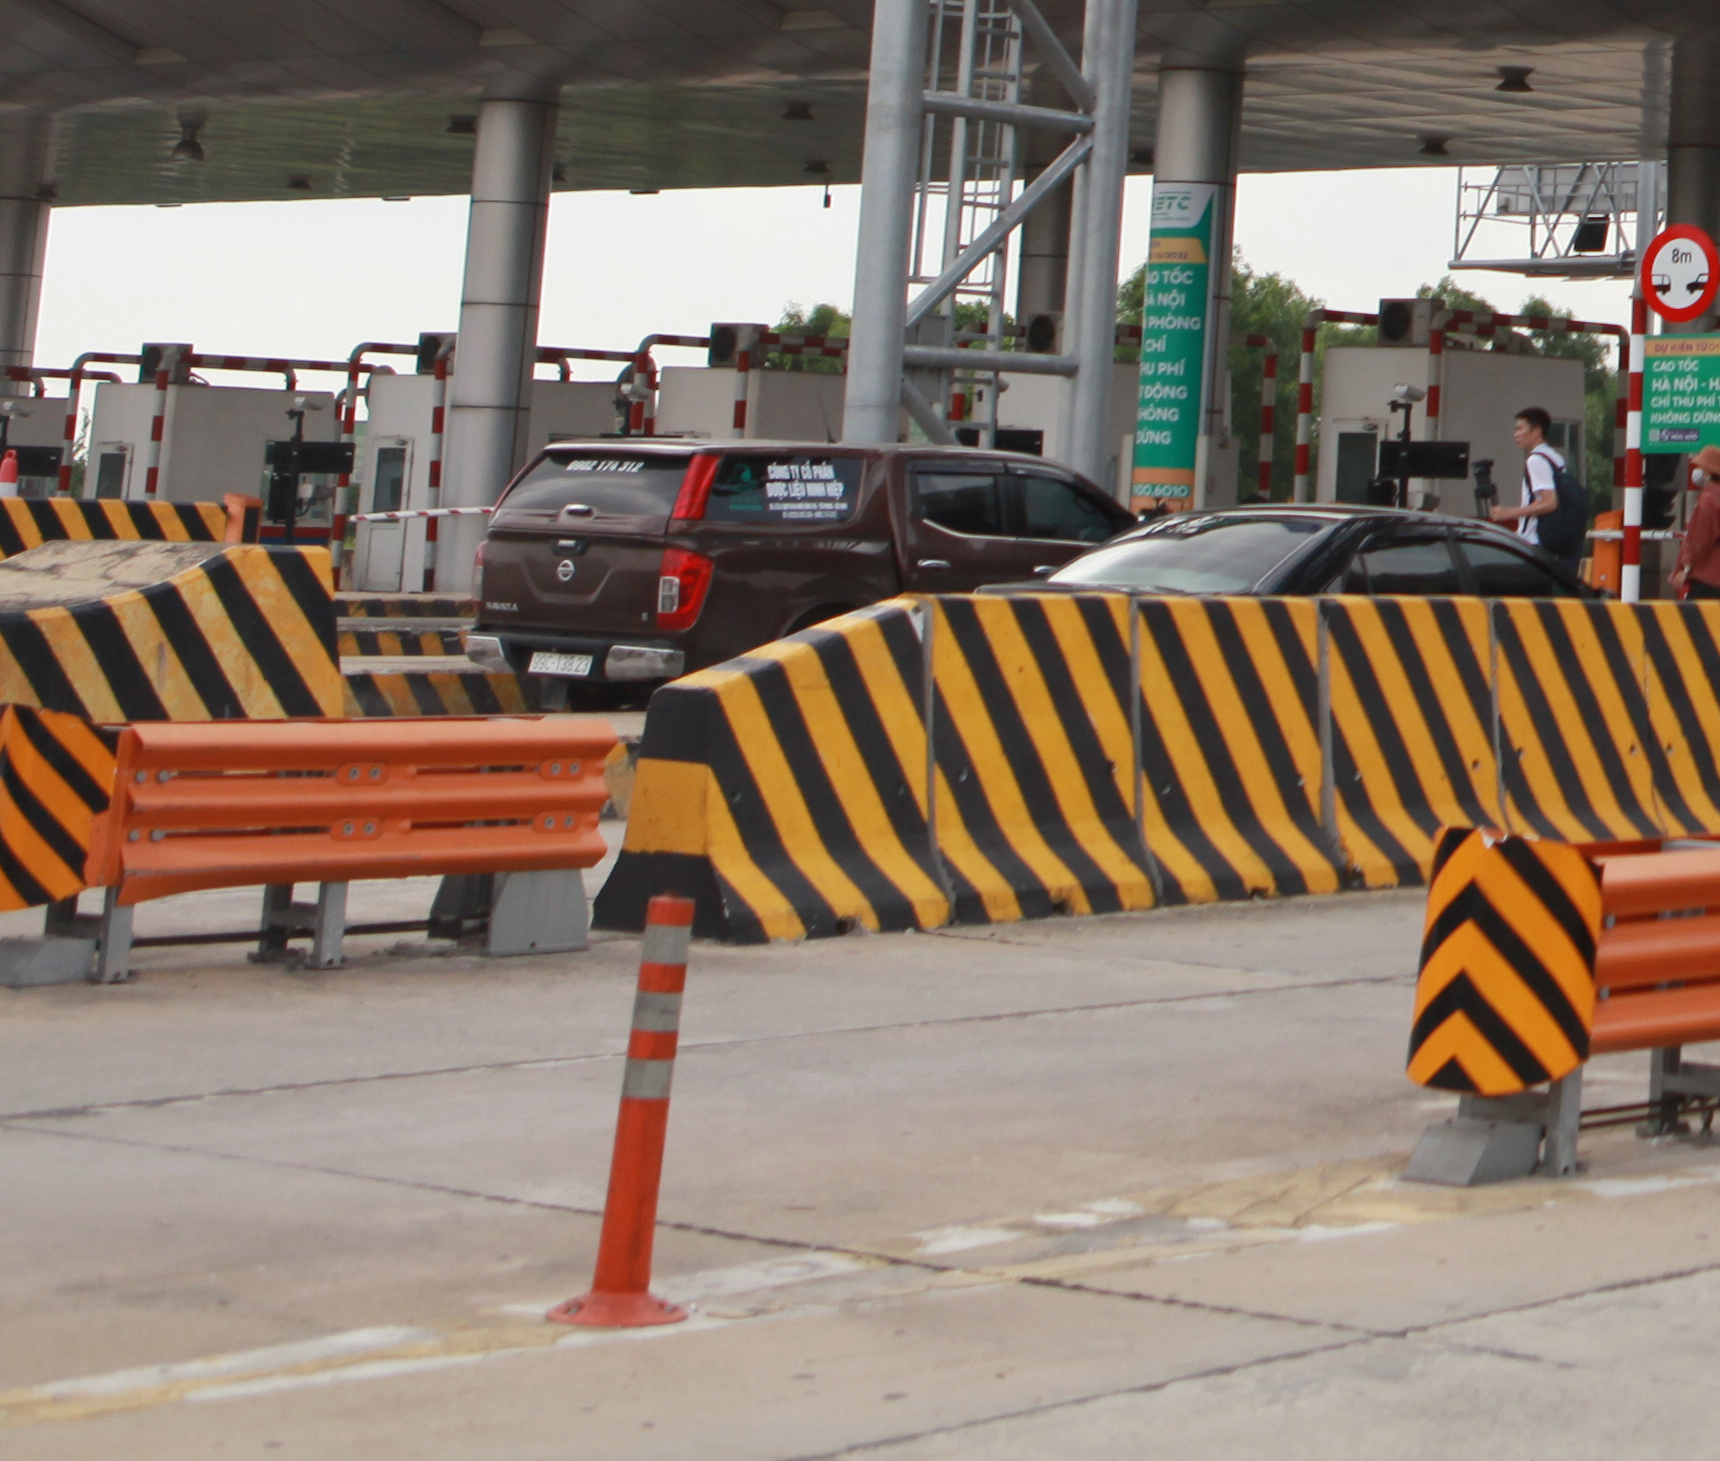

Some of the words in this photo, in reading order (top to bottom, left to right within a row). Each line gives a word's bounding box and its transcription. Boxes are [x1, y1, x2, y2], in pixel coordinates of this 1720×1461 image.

[1671, 248, 1692, 264] 8m
[1162, 265, 1194, 285] TỐC
[1157, 288, 1186, 309] NỘI
[1148, 312, 1202, 330] PHÒNG
[1158, 358, 1187, 376] PHÍ
[1652, 360, 1675, 372] CAO
[1678, 356, 1700, 372] TỐC
[1652, 374, 1671, 391] HÀ
[1673, 373, 1698, 394] NỘI
